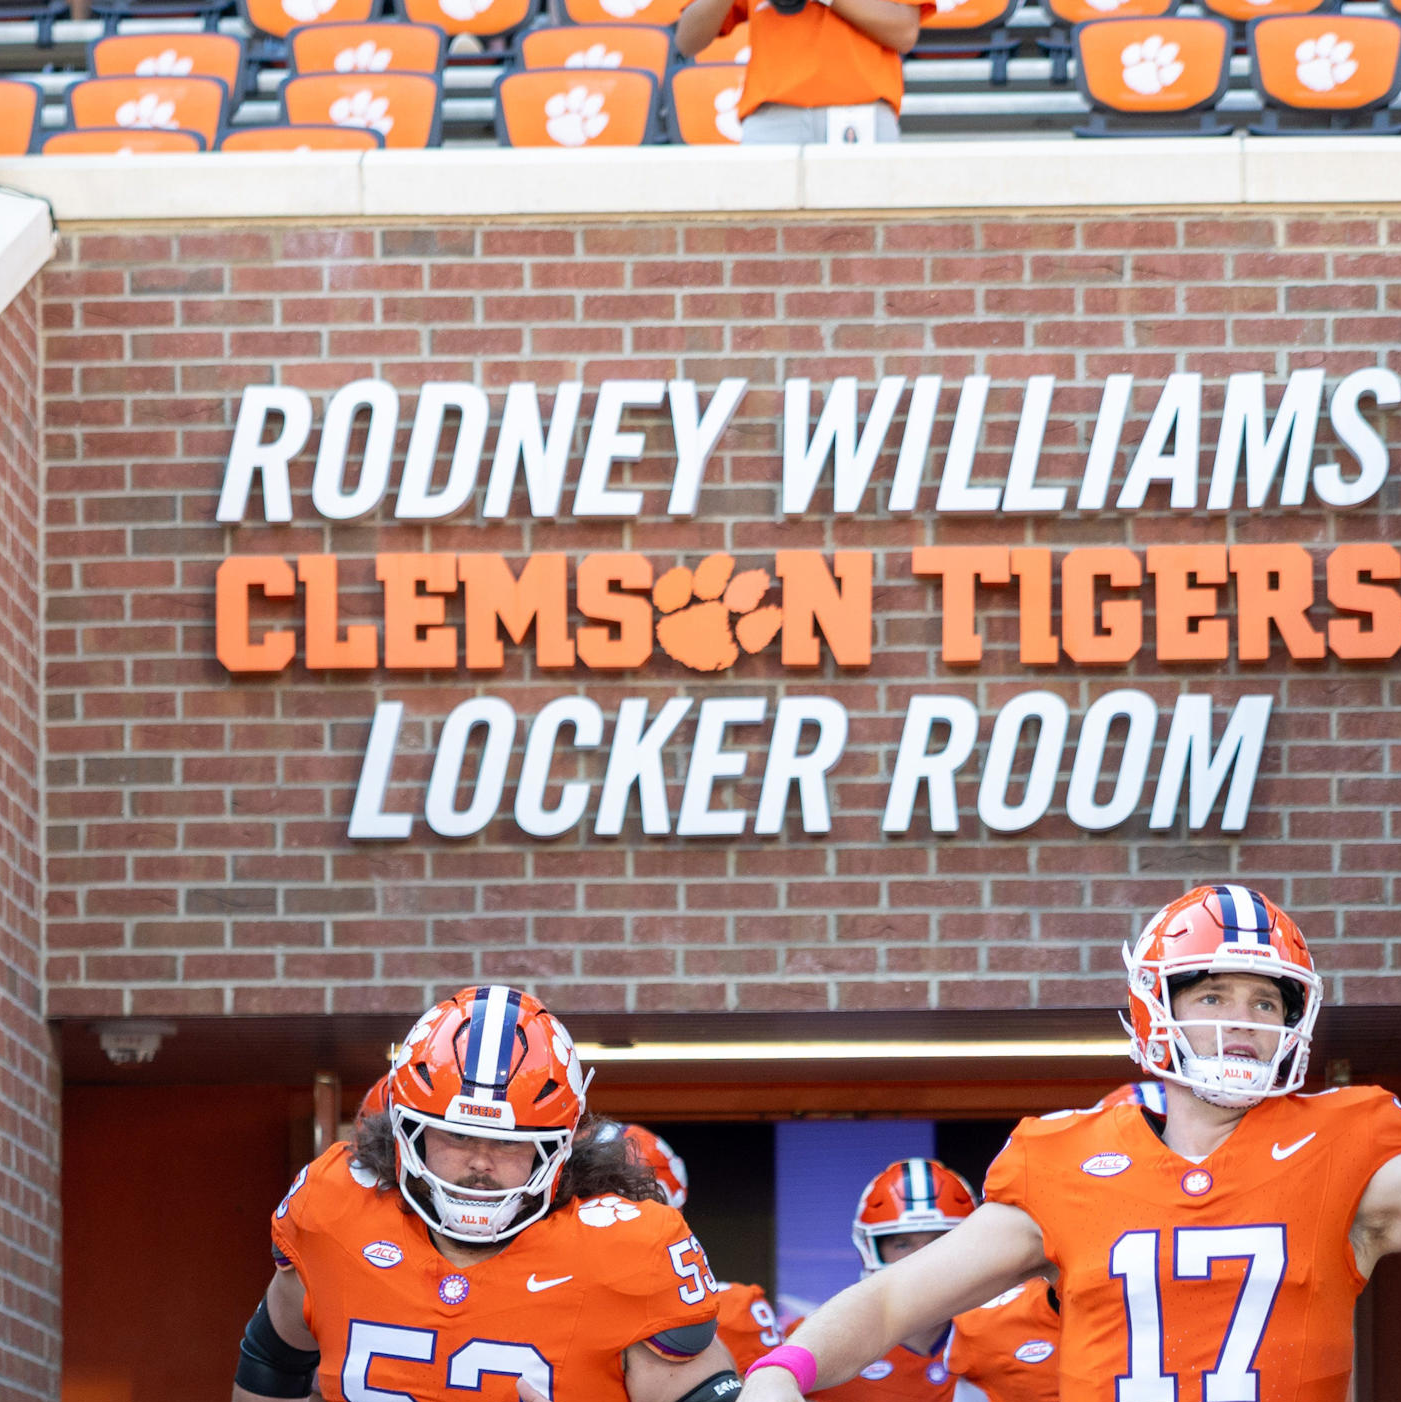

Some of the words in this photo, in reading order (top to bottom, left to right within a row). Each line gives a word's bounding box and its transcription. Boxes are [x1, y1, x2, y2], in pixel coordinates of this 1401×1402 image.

[215, 378, 748, 522] RODNEY
[348, 695, 849, 838] LOCKER
[882, 689, 1273, 833] ROOM
[1223, 1068, 1242, 1079] ALL
[1242, 1070, 1253, 1081] IN
[459, 1102, 503, 1119] TIGERS
[1089, 1157, 1125, 1169] ACC
[460, 1214, 477, 1225] ALL
[478, 1215, 489, 1226] IN
[369, 1247, 399, 1260] ACC
[666, 1233, 719, 1306] 53
